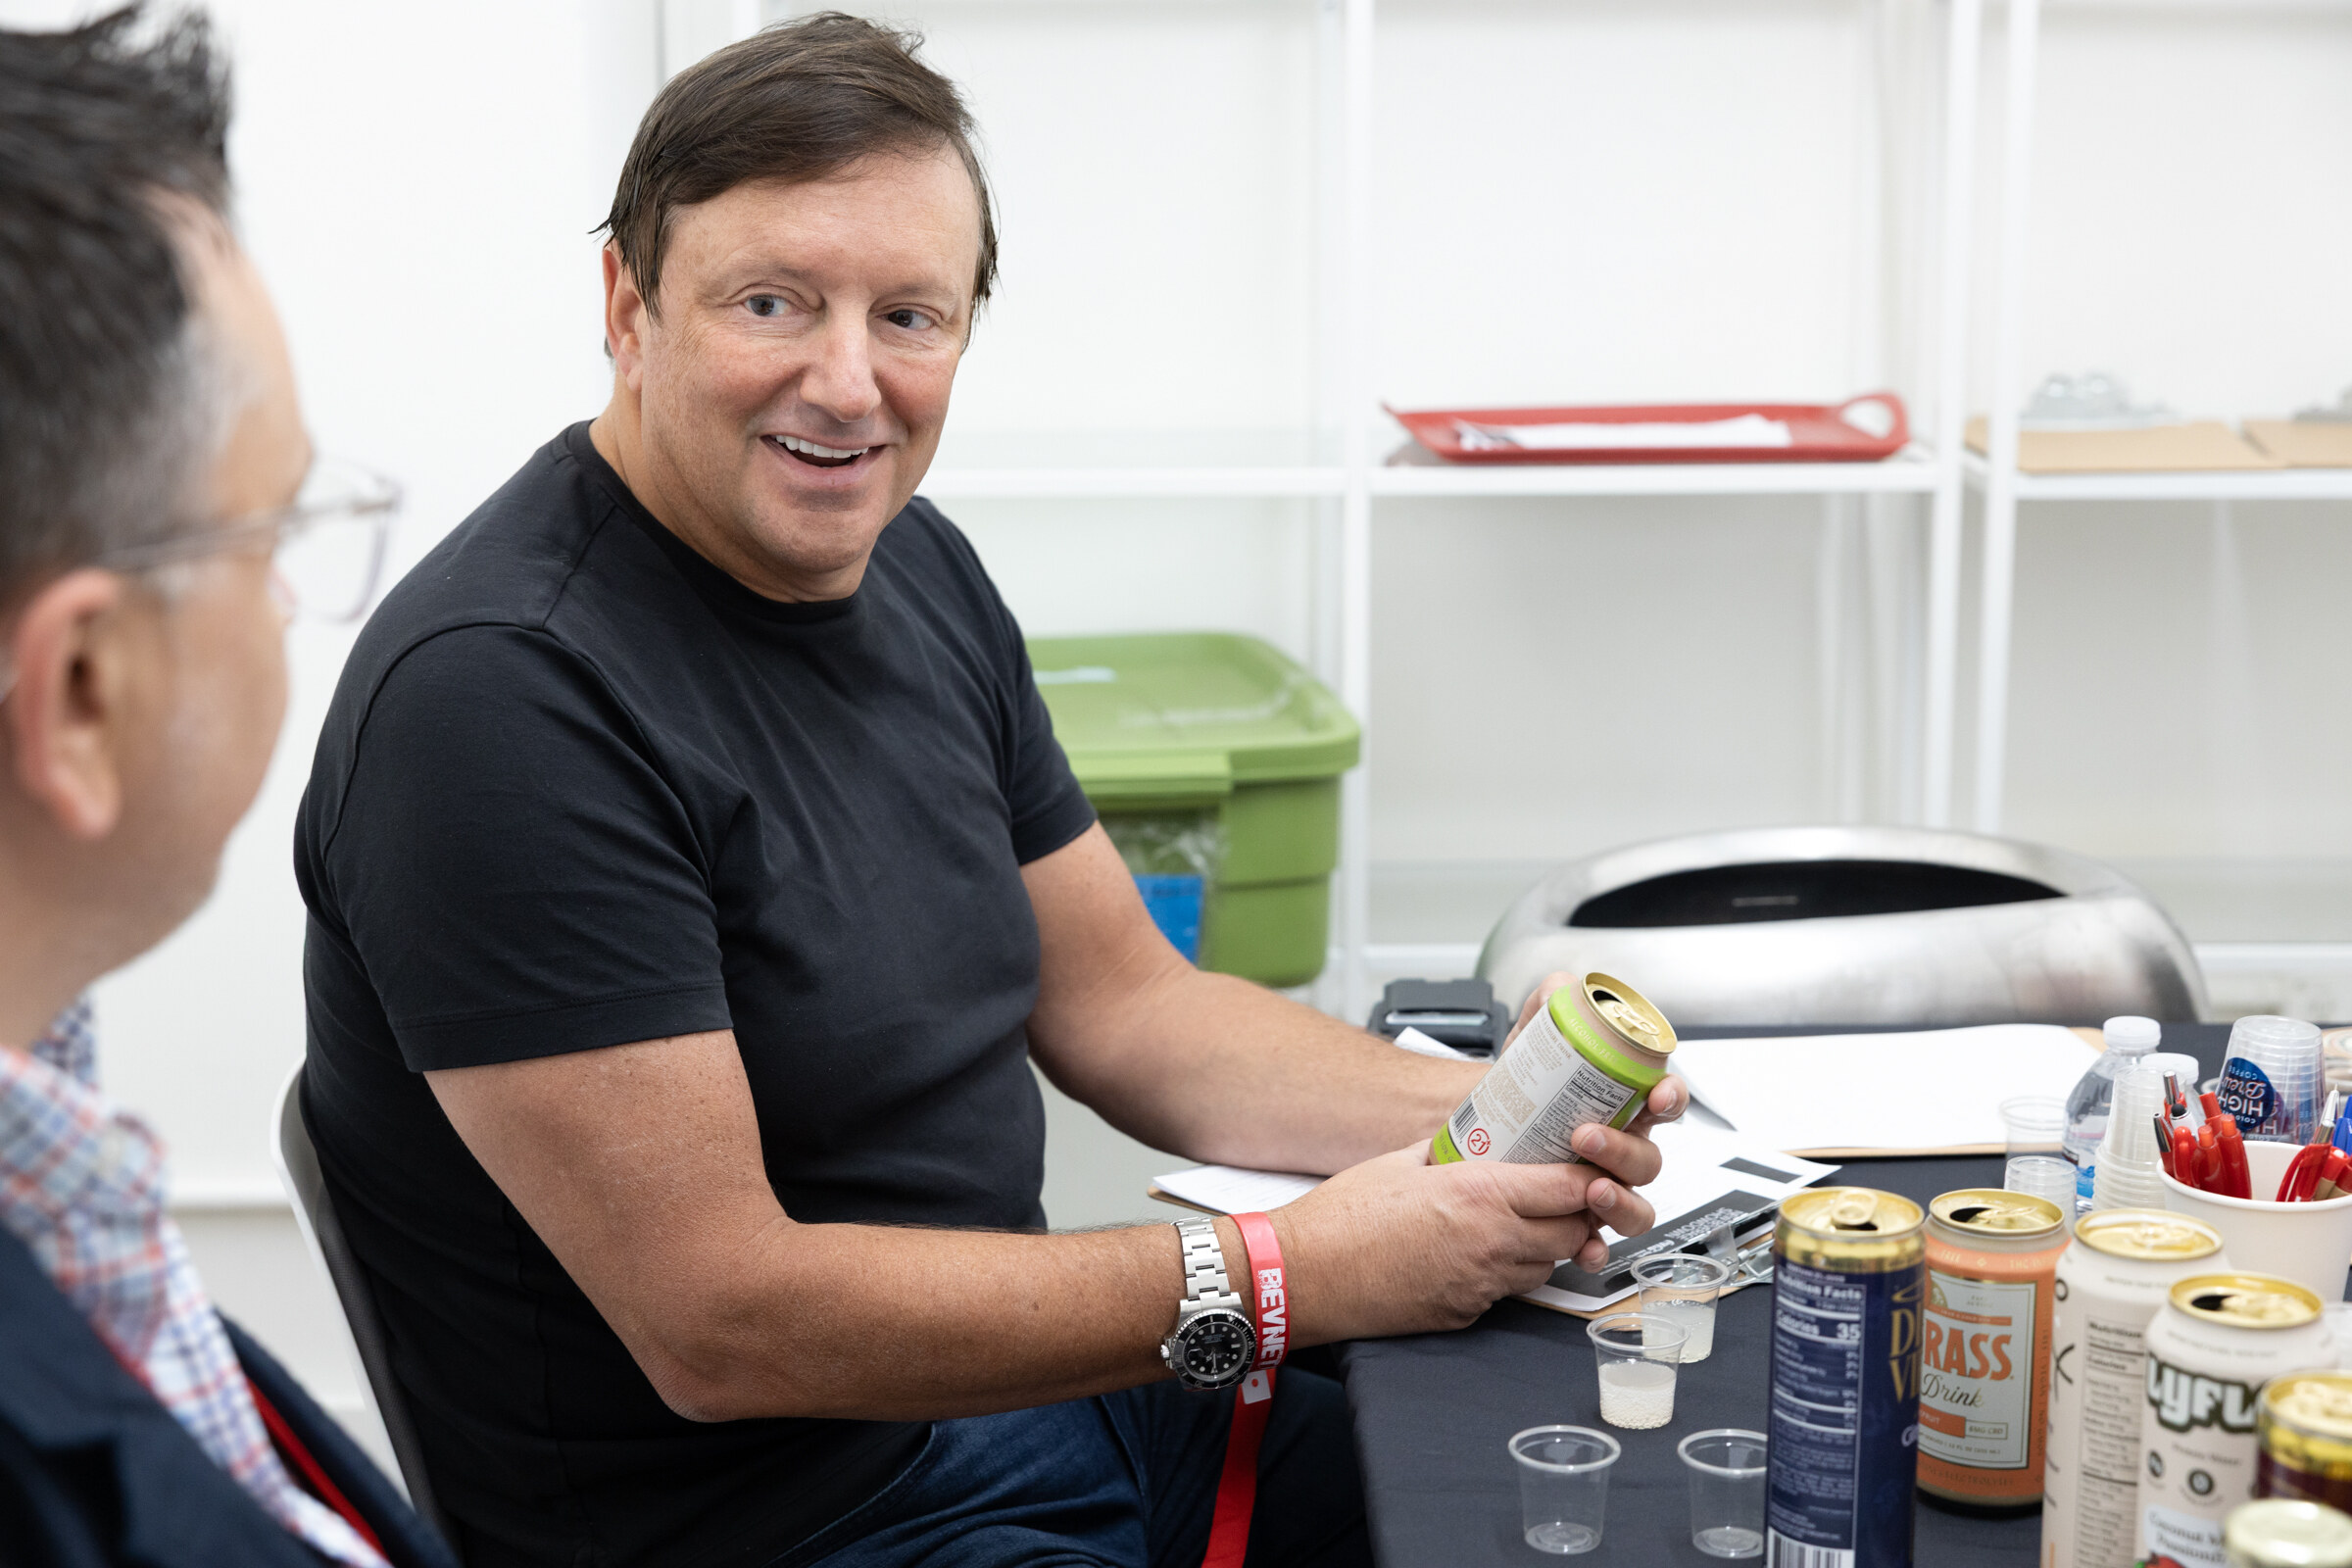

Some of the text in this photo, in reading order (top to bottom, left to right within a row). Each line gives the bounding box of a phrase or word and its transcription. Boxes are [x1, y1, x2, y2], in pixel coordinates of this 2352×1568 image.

[1577, 1070, 1623, 1102] Nutrition Facts
[1824, 1285, 1862, 1299] Facts
[1257, 1267, 1286, 1370] BEVNET
[1837, 1322, 1861, 1340] 35
[1924, 1318, 2013, 1382] RASS
[1921, 1373, 1984, 1407] Drink
